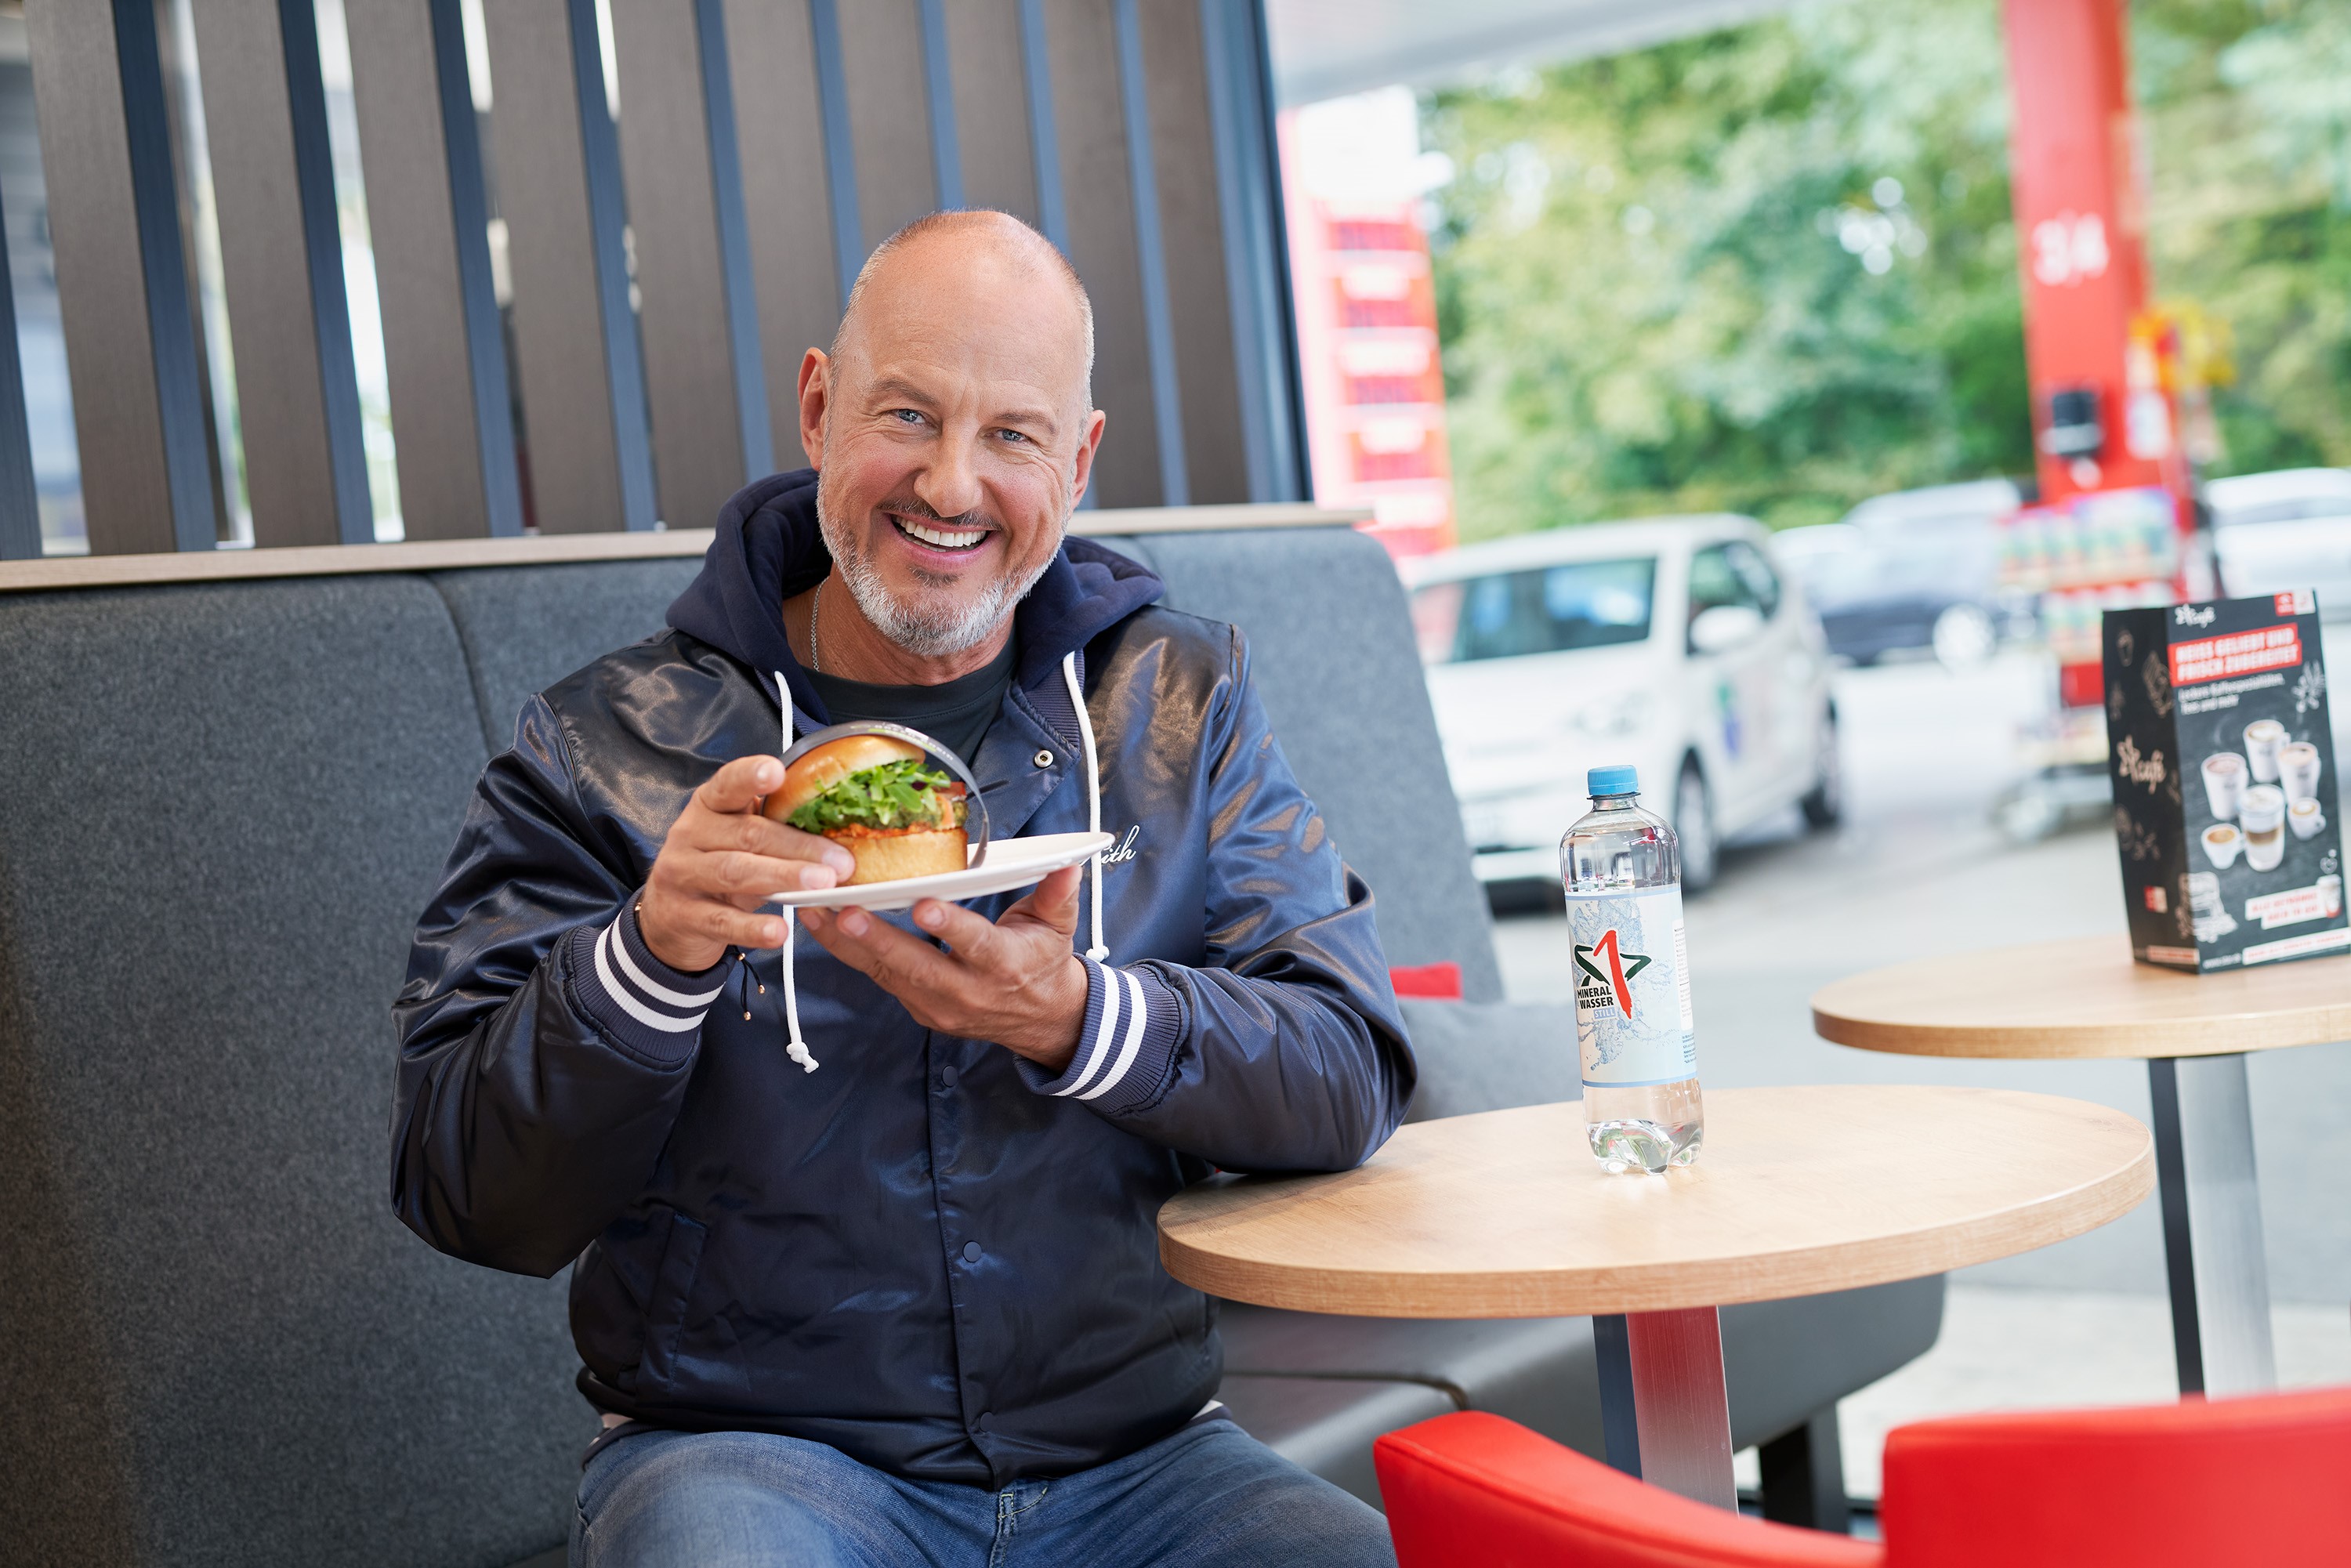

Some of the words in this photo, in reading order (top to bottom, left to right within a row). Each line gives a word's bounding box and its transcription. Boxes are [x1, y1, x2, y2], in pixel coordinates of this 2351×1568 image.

[2215, 632, 2265, 657] GELIEBT
[2266, 628, 2295, 648] UND
[2177, 657, 2224, 681] FRISCH
[2225, 644, 2298, 673] ZUBEREITET
[2201, 697, 2218, 712] und
[2218, 693, 2239, 708] mehr
[1577, 986, 1612, 999] MINERAL
[1579, 996, 1614, 1009] WASSER
[1594, 1009, 1614, 1018] STILL
